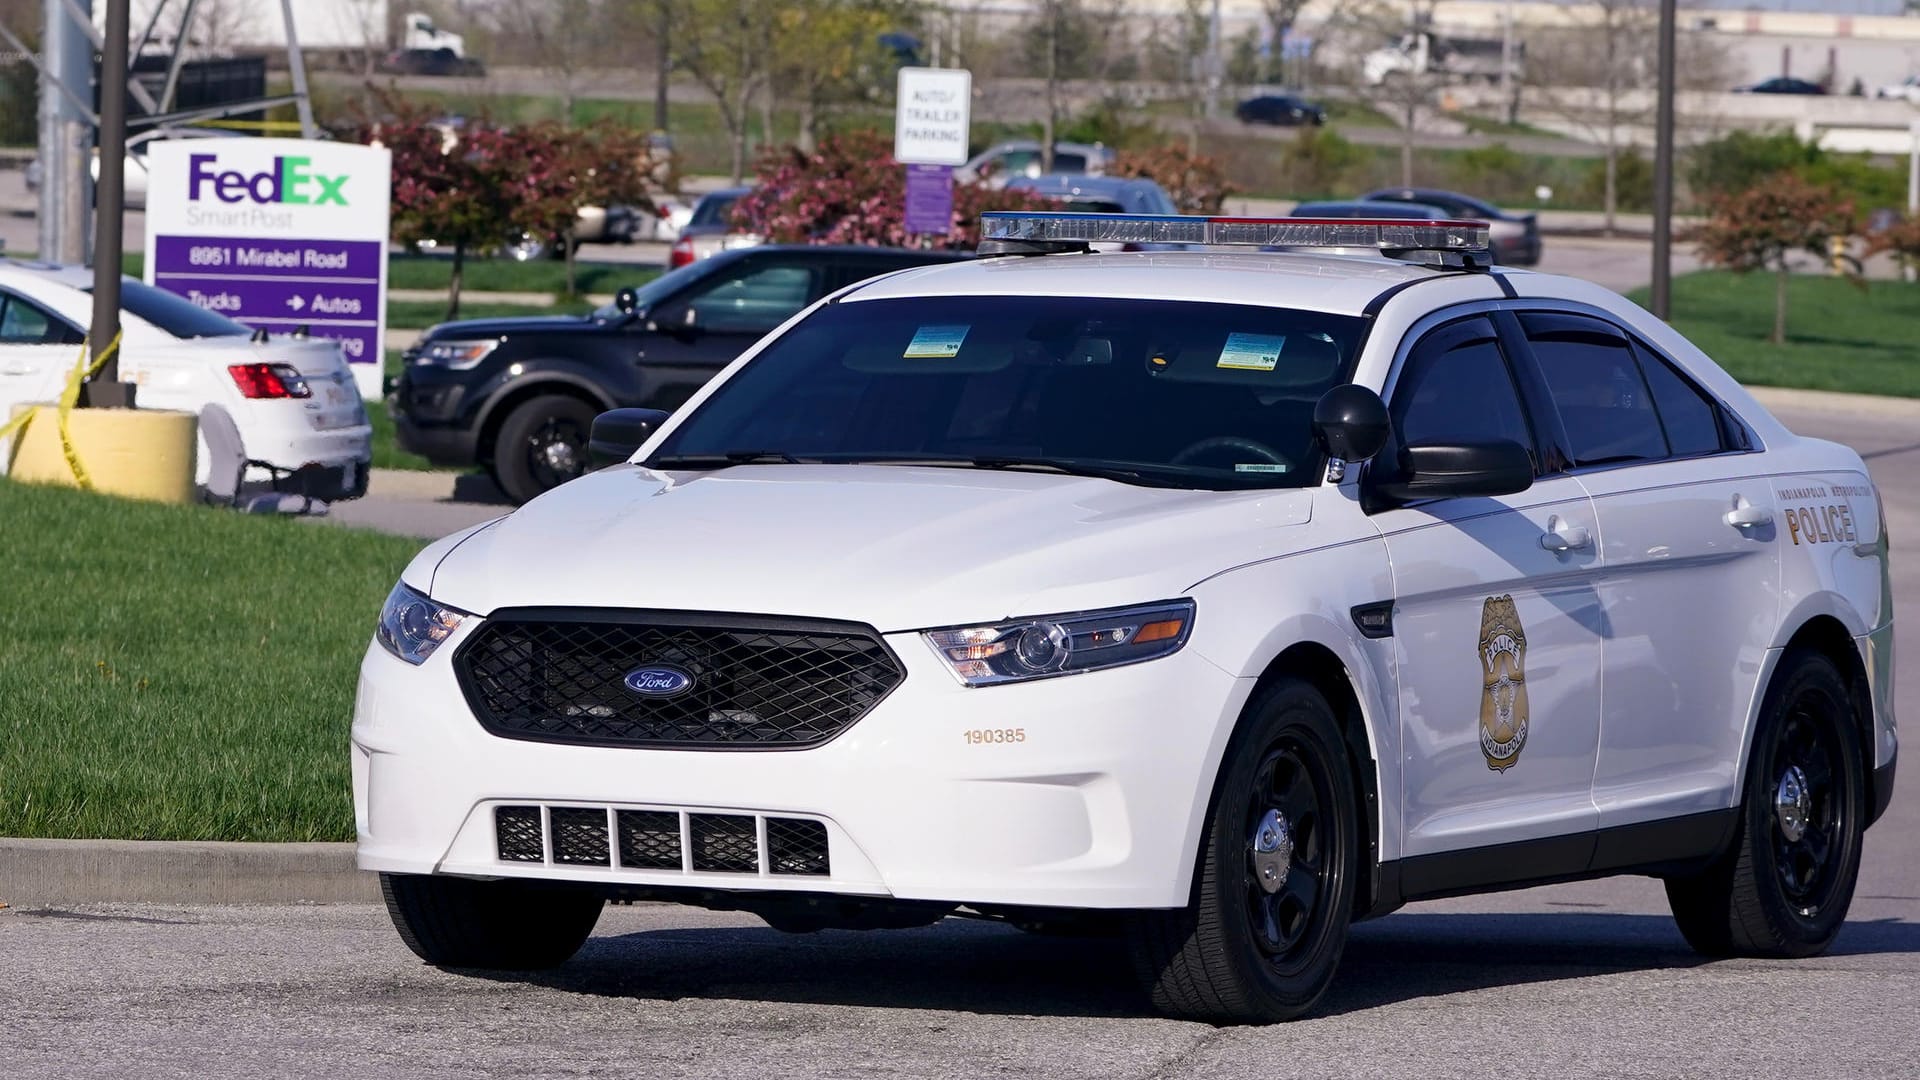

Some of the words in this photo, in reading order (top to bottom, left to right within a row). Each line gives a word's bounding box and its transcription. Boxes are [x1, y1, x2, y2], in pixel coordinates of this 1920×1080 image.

[906, 108, 961, 123] TRAILER
[904, 127, 960, 143] PARKING
[189, 153, 350, 206] FedEx
[189, 246, 231, 266] 8951
[236, 247, 300, 268] Mirabel
[304, 249, 348, 269] Road
[187, 290, 242, 311] Trucks
[311, 293, 362, 314] Autos
[1784, 505, 1855, 546] POLICE
[1486, 636, 1519, 660] POLICE
[636, 671, 674, 688] Ford
[963, 728, 1026, 745] 190385
[1482, 723, 1526, 757] INDIANAPOLIS
